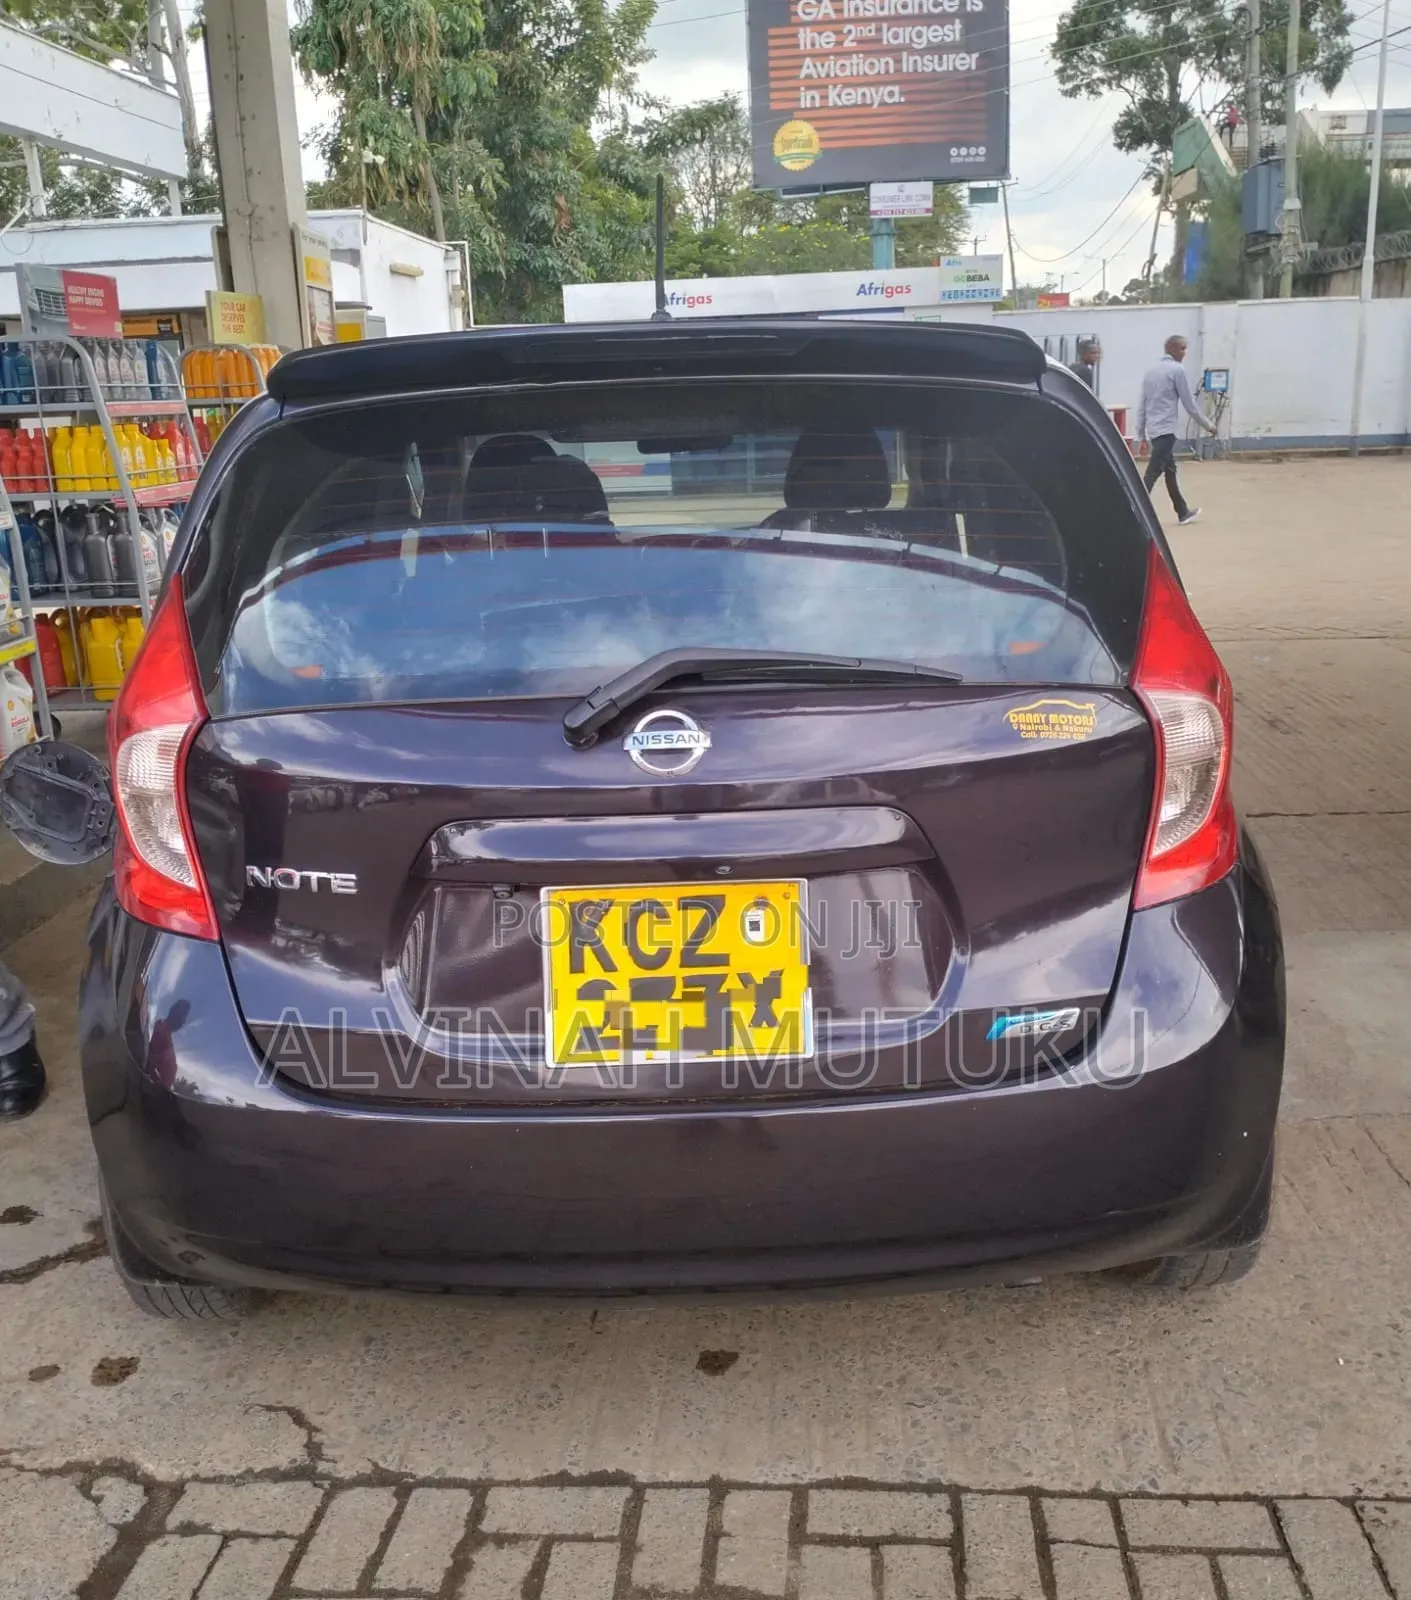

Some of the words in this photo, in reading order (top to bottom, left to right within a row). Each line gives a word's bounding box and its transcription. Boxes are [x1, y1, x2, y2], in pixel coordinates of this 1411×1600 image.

[797, 0, 836, 20] GA
[843, 0, 959, 18] Insurance
[798, 27, 836, 50] the
[843, 23, 875, 48] 2nd
[881, 18, 962, 49] largest
[800, 54, 894, 79] Aviation
[902, 52, 979, 73] Insurer
[800, 86, 820, 108] in
[828, 84, 905, 108] Kenya.
[856, 281, 912, 298] Afrigas
[1020, 723, 1052, 732] Nairobi
[1049, 713, 1094, 726] MOTORS
[631, 734, 701, 746] NISSAN
[246, 865, 359, 895] NOTE
[569, 894, 731, 974] KCZ
